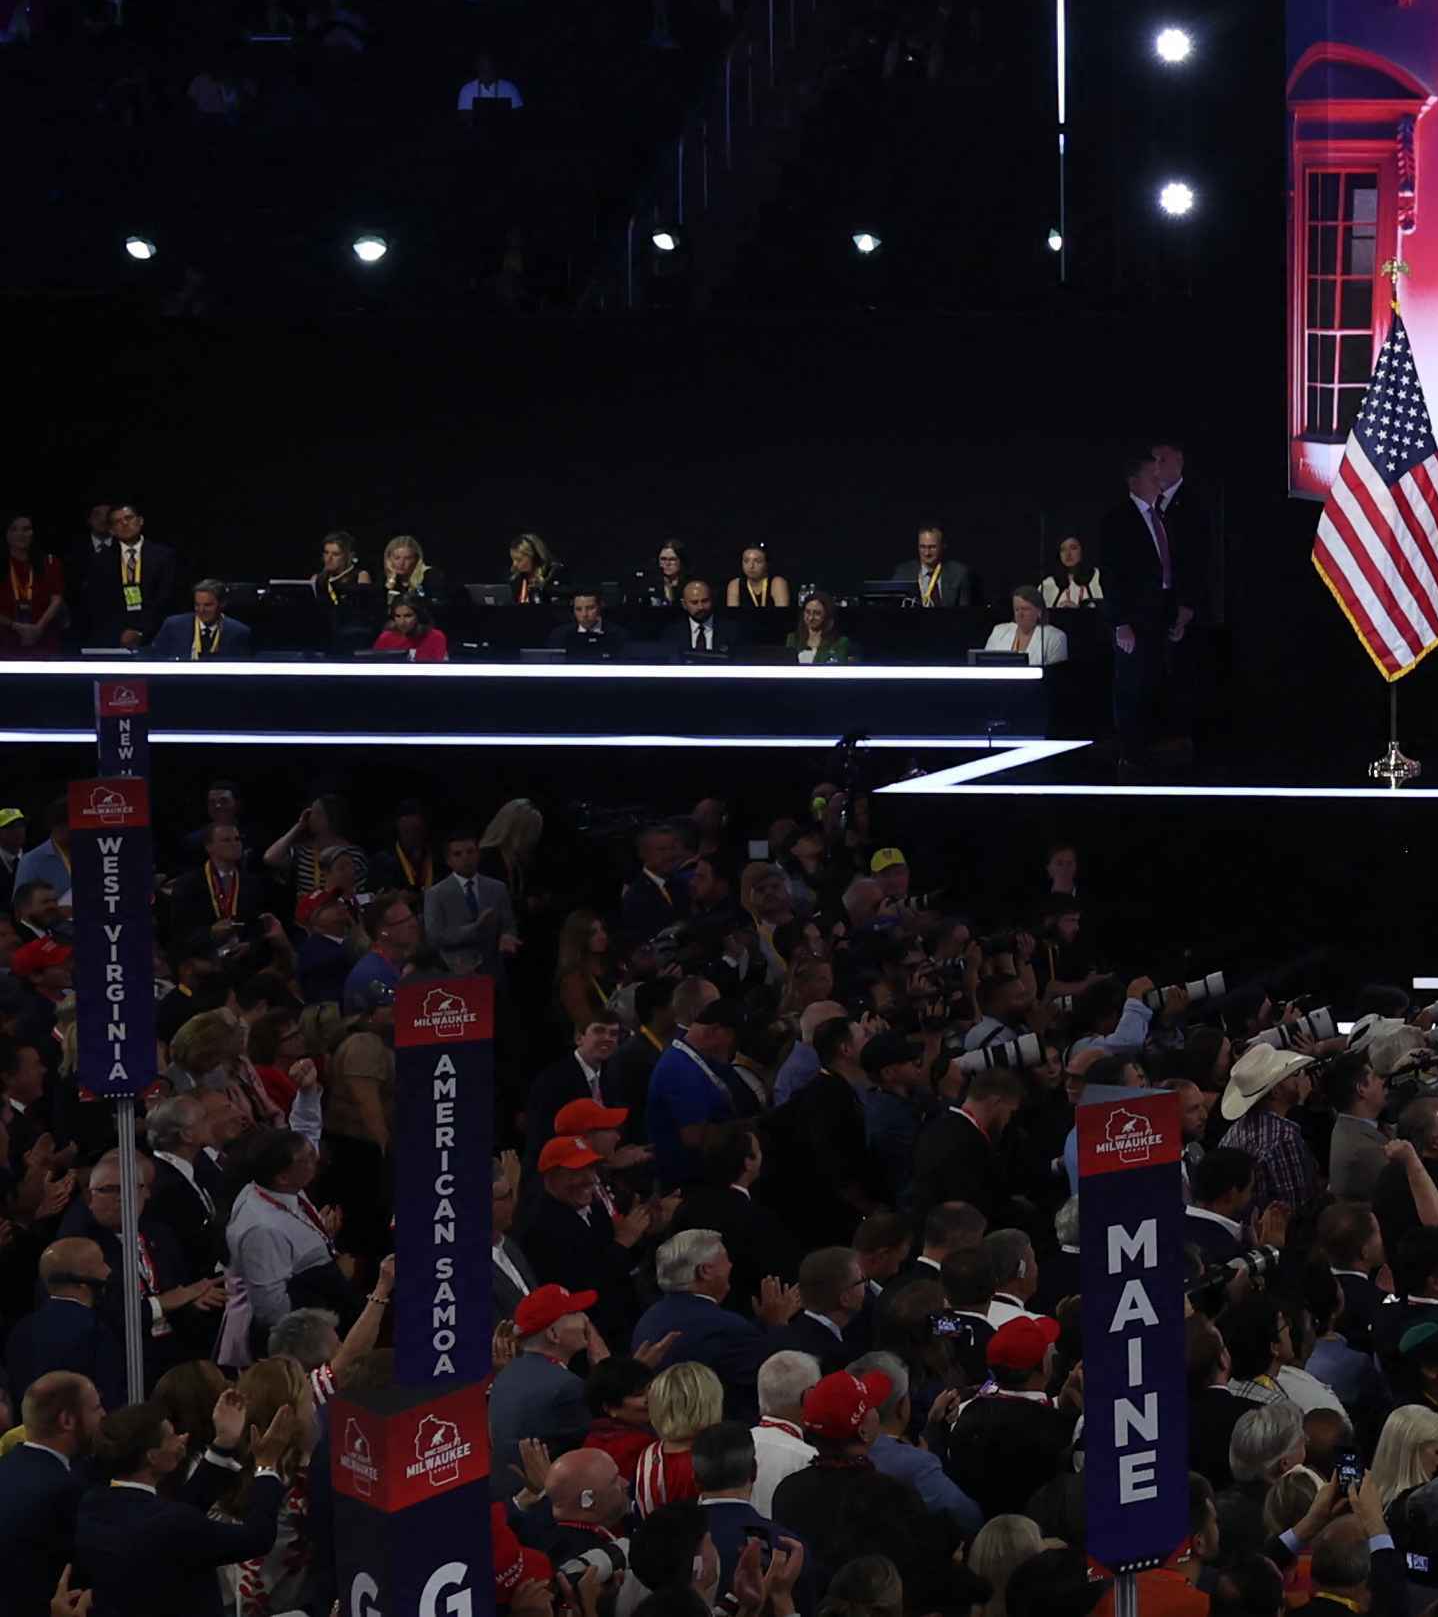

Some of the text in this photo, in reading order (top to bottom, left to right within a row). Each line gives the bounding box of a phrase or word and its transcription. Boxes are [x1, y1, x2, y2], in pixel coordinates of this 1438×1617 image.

[118, 718, 134, 760] NEW
[97, 836, 124, 914] WEST
[103, 924, 129, 1081] VIRGINIA
[413, 1013, 477, 1028] MILWAUKEE
[1095, 1133, 1164, 1154] MILWAUKEE
[433, 1054, 457, 1377] AMERICAN SAMOA
[1106, 1217, 1161, 1506] MAINE
[406, 1442, 472, 1479] MILWAUKEE
